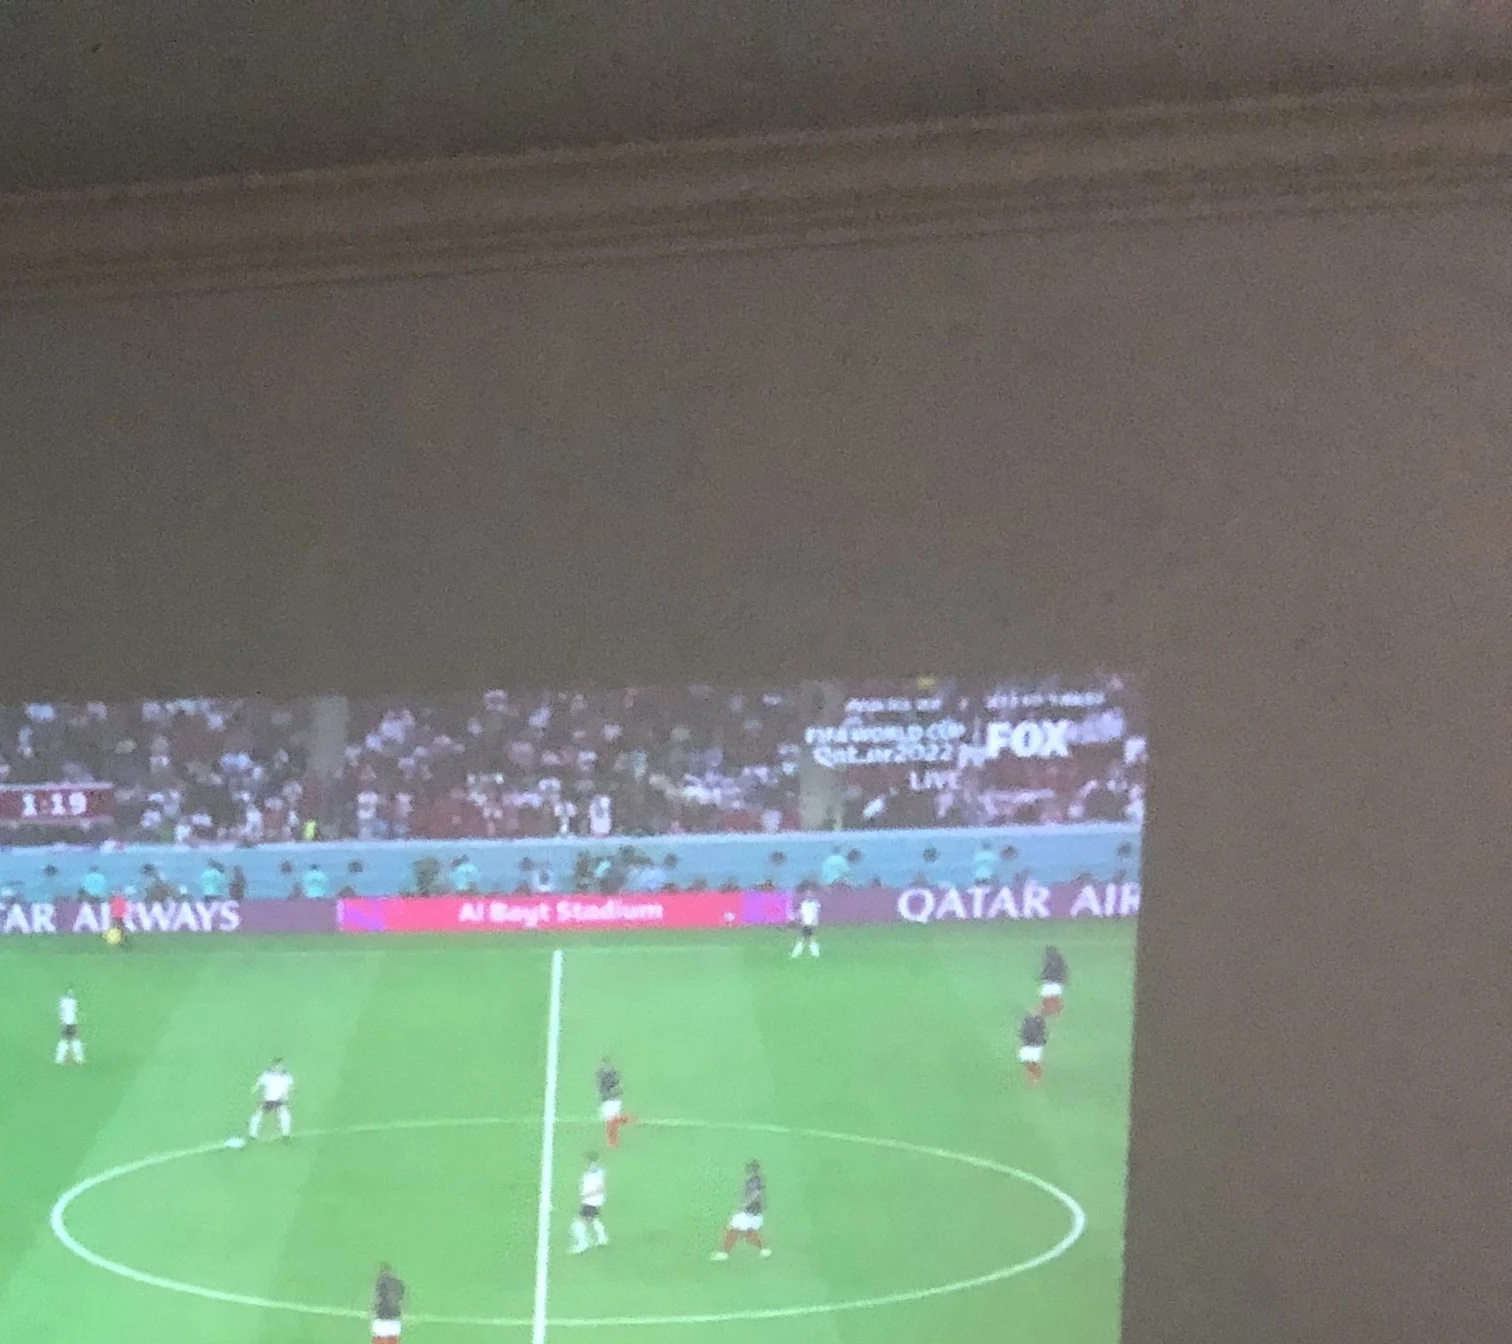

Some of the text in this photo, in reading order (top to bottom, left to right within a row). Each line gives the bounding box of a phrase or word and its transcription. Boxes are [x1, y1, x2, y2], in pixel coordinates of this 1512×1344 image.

[988, 721, 1070, 757] FOX
[556, 900, 664, 922] Stadium
[897, 883, 1050, 924] QATAR
